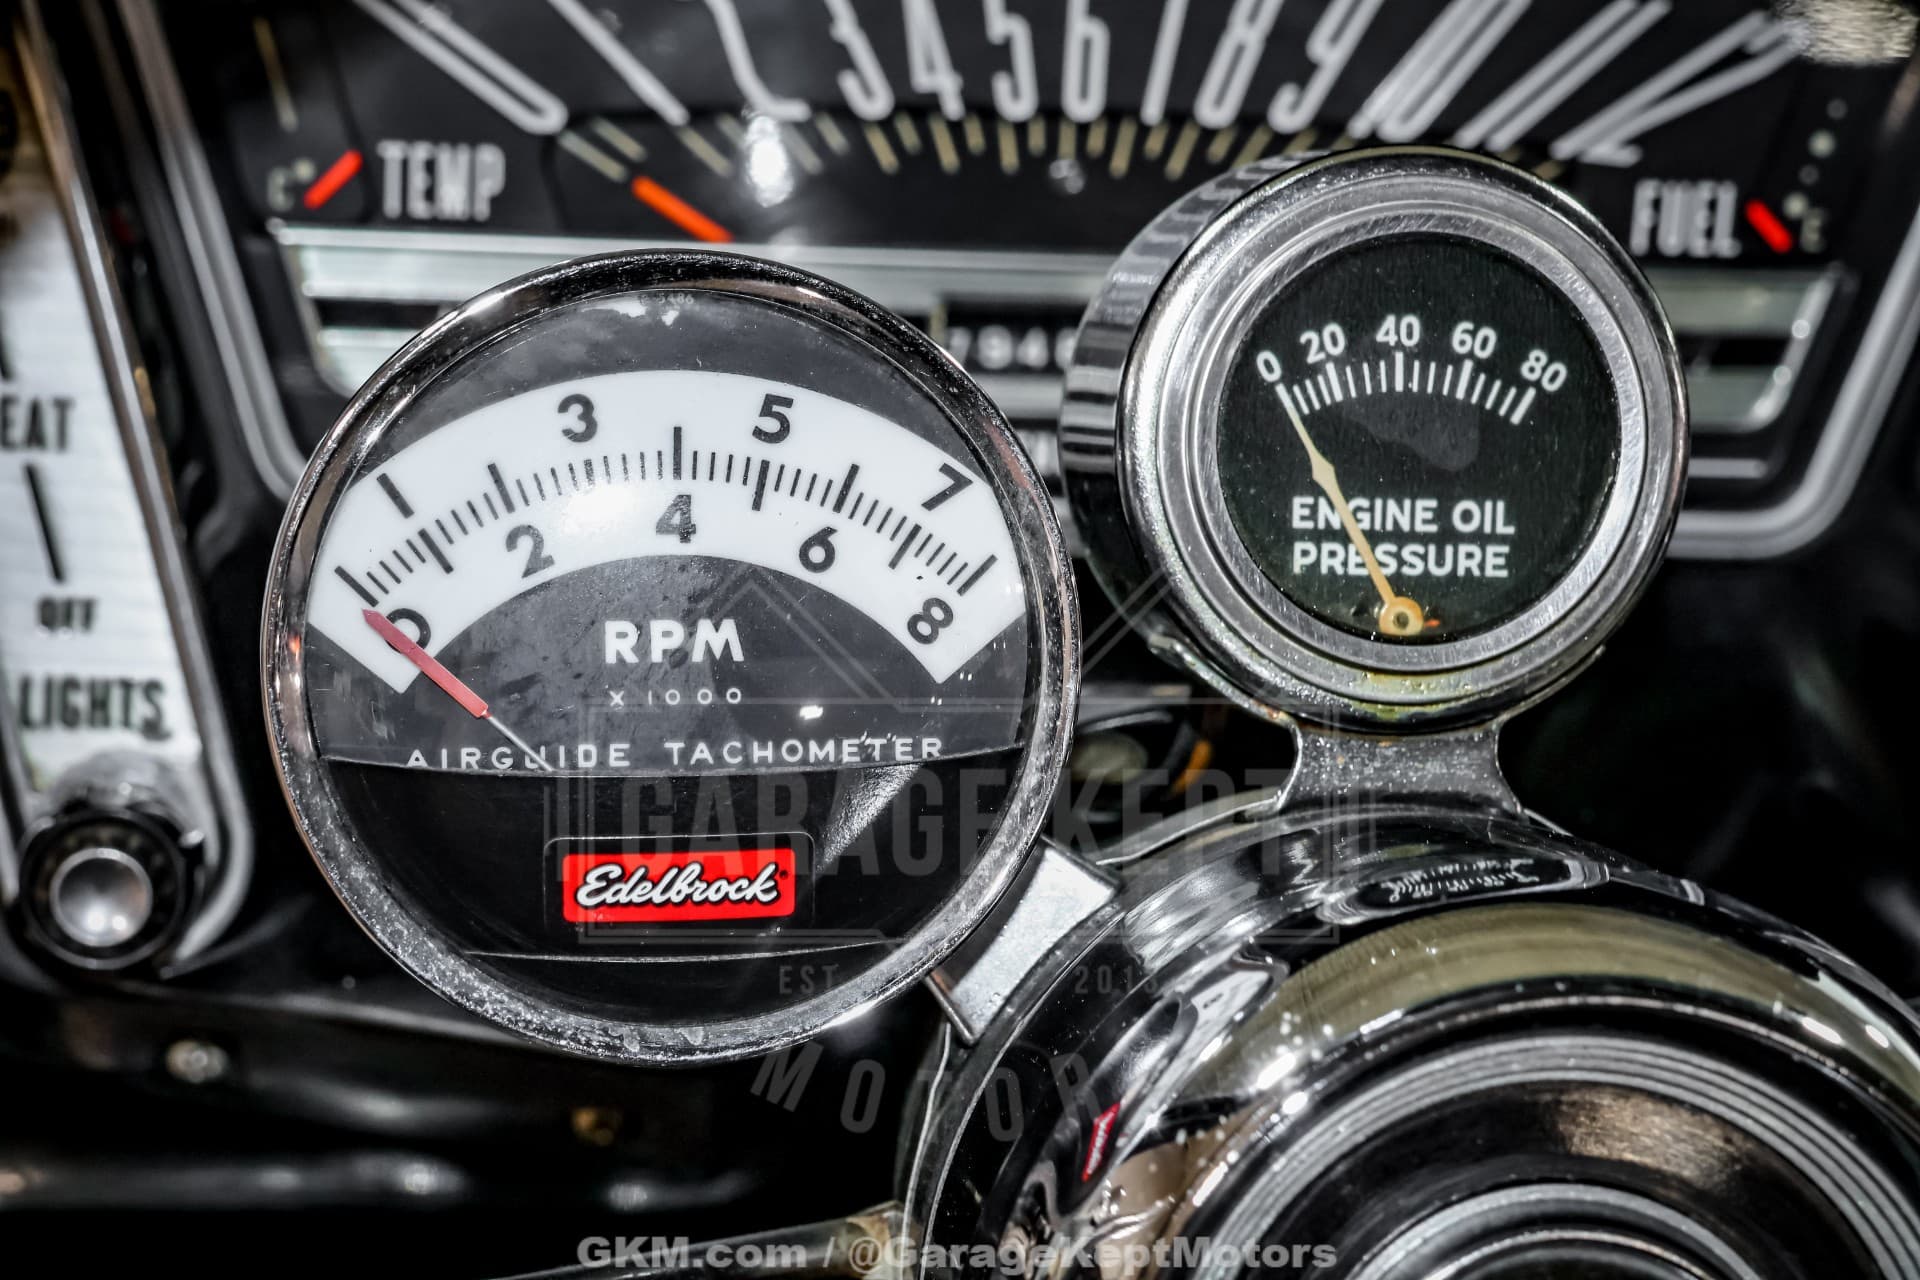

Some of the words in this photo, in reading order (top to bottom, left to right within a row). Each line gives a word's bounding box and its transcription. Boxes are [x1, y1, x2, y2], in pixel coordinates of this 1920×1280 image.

[984, 0, 1038, 122] 5
[377, 140, 506, 221] TEMP
[1630, 178, 1742, 258] FUEL
[1256, 350, 1282, 383] 0
[1299, 322, 1346, 364] 20
[1375, 314, 1421, 347] 40
[1451, 321, 1497, 360] 60
[1520, 349, 1567, 393] 80
[557, 393, 598, 443] 3
[752, 394, 794, 444] 5
[921, 463, 973, 511] 7
[1291, 496, 1438, 533] ENGINE
[1452, 499, 1515, 535] OIL
[505, 524, 556, 579] 2
[655, 494, 697, 543] 4
[798, 526, 838, 573] 6
[907, 597, 954, 645] 8
[1292, 542, 1510, 578] PRESSURE
[38, 597, 97, 630] OFF
[605, 619, 744, 664] RPM
[19, 676, 172, 742] LIGHTS
[406, 743, 631, 770] AIRGUIDE
[664, 737, 943, 766] TACHOMETER
[576, 862, 780, 908] Edelbrock
